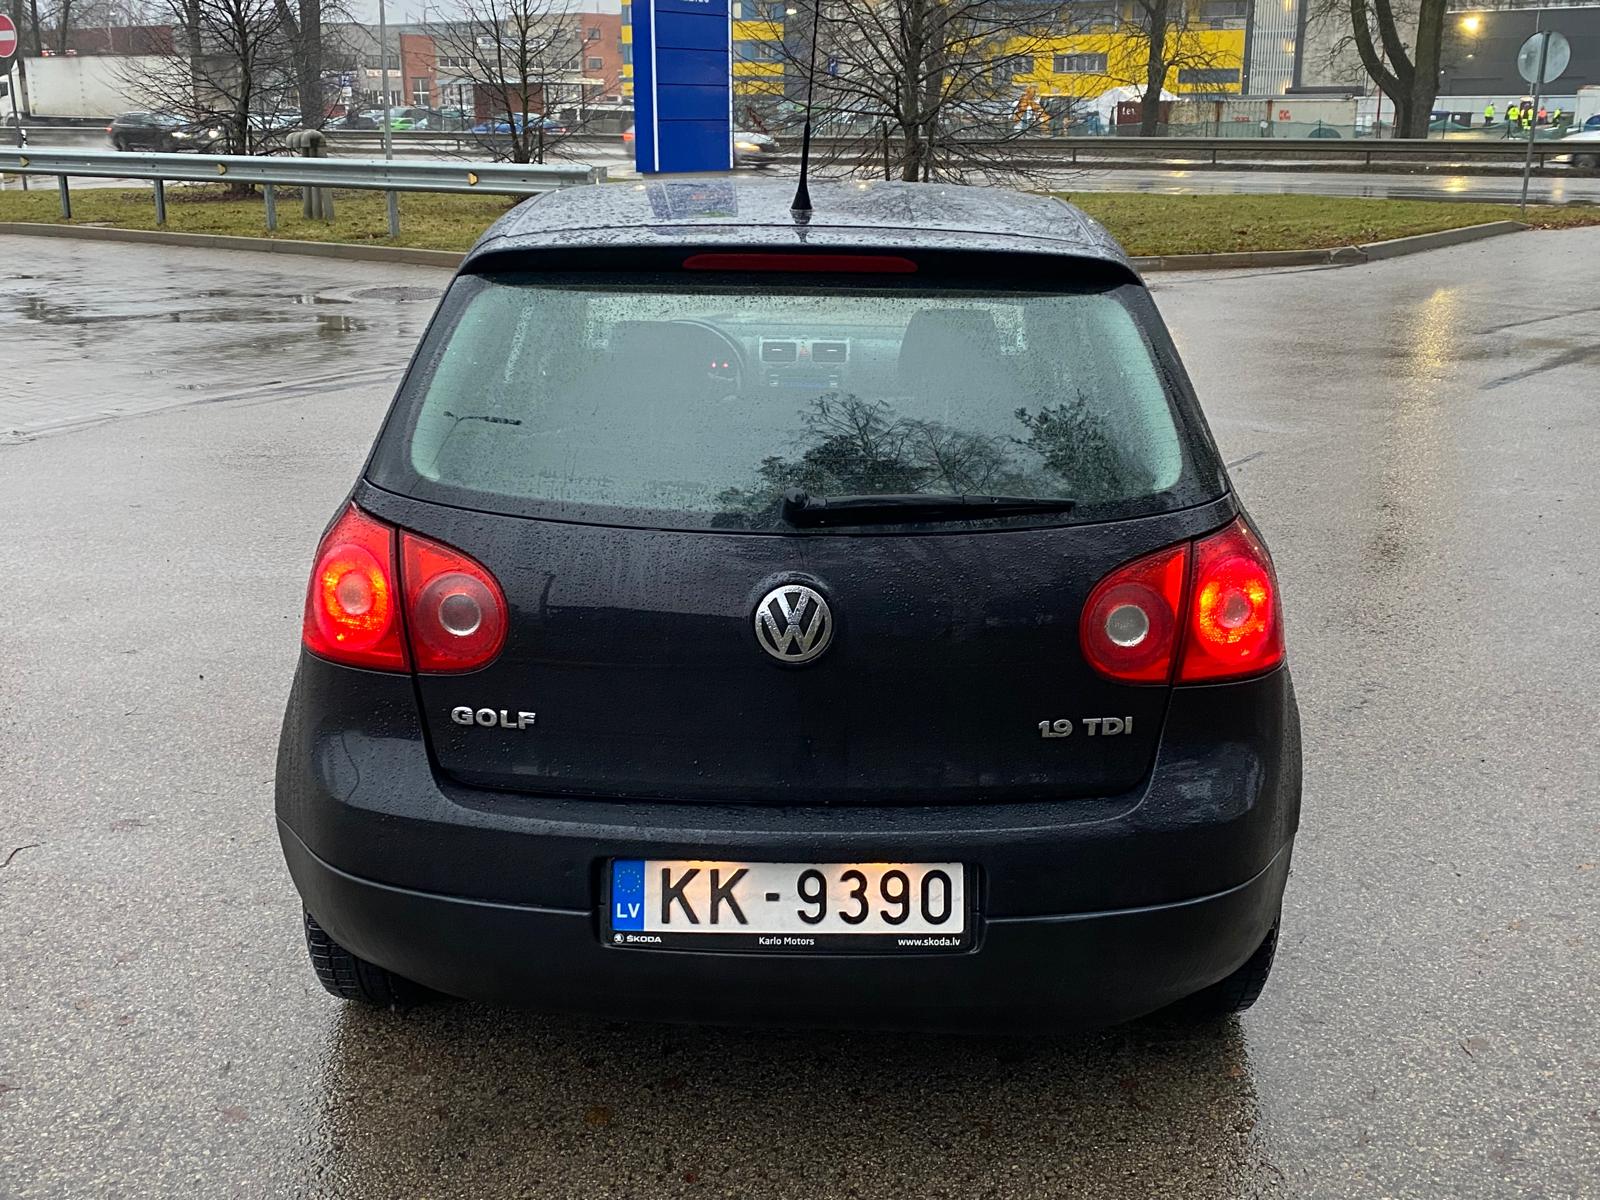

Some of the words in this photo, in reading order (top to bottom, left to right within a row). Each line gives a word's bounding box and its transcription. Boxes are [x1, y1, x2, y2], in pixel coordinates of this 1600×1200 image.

[451, 706, 536, 730] GOLF
[1082, 716, 1133, 736] TDI
[616, 903, 640, 919] LV
[626, 934, 662, 943] ŠKODA
[758, 936, 782, 945] Karlo
[783, 936, 815, 946] Motors
[897, 936, 961, 946] www.skoda.lv
